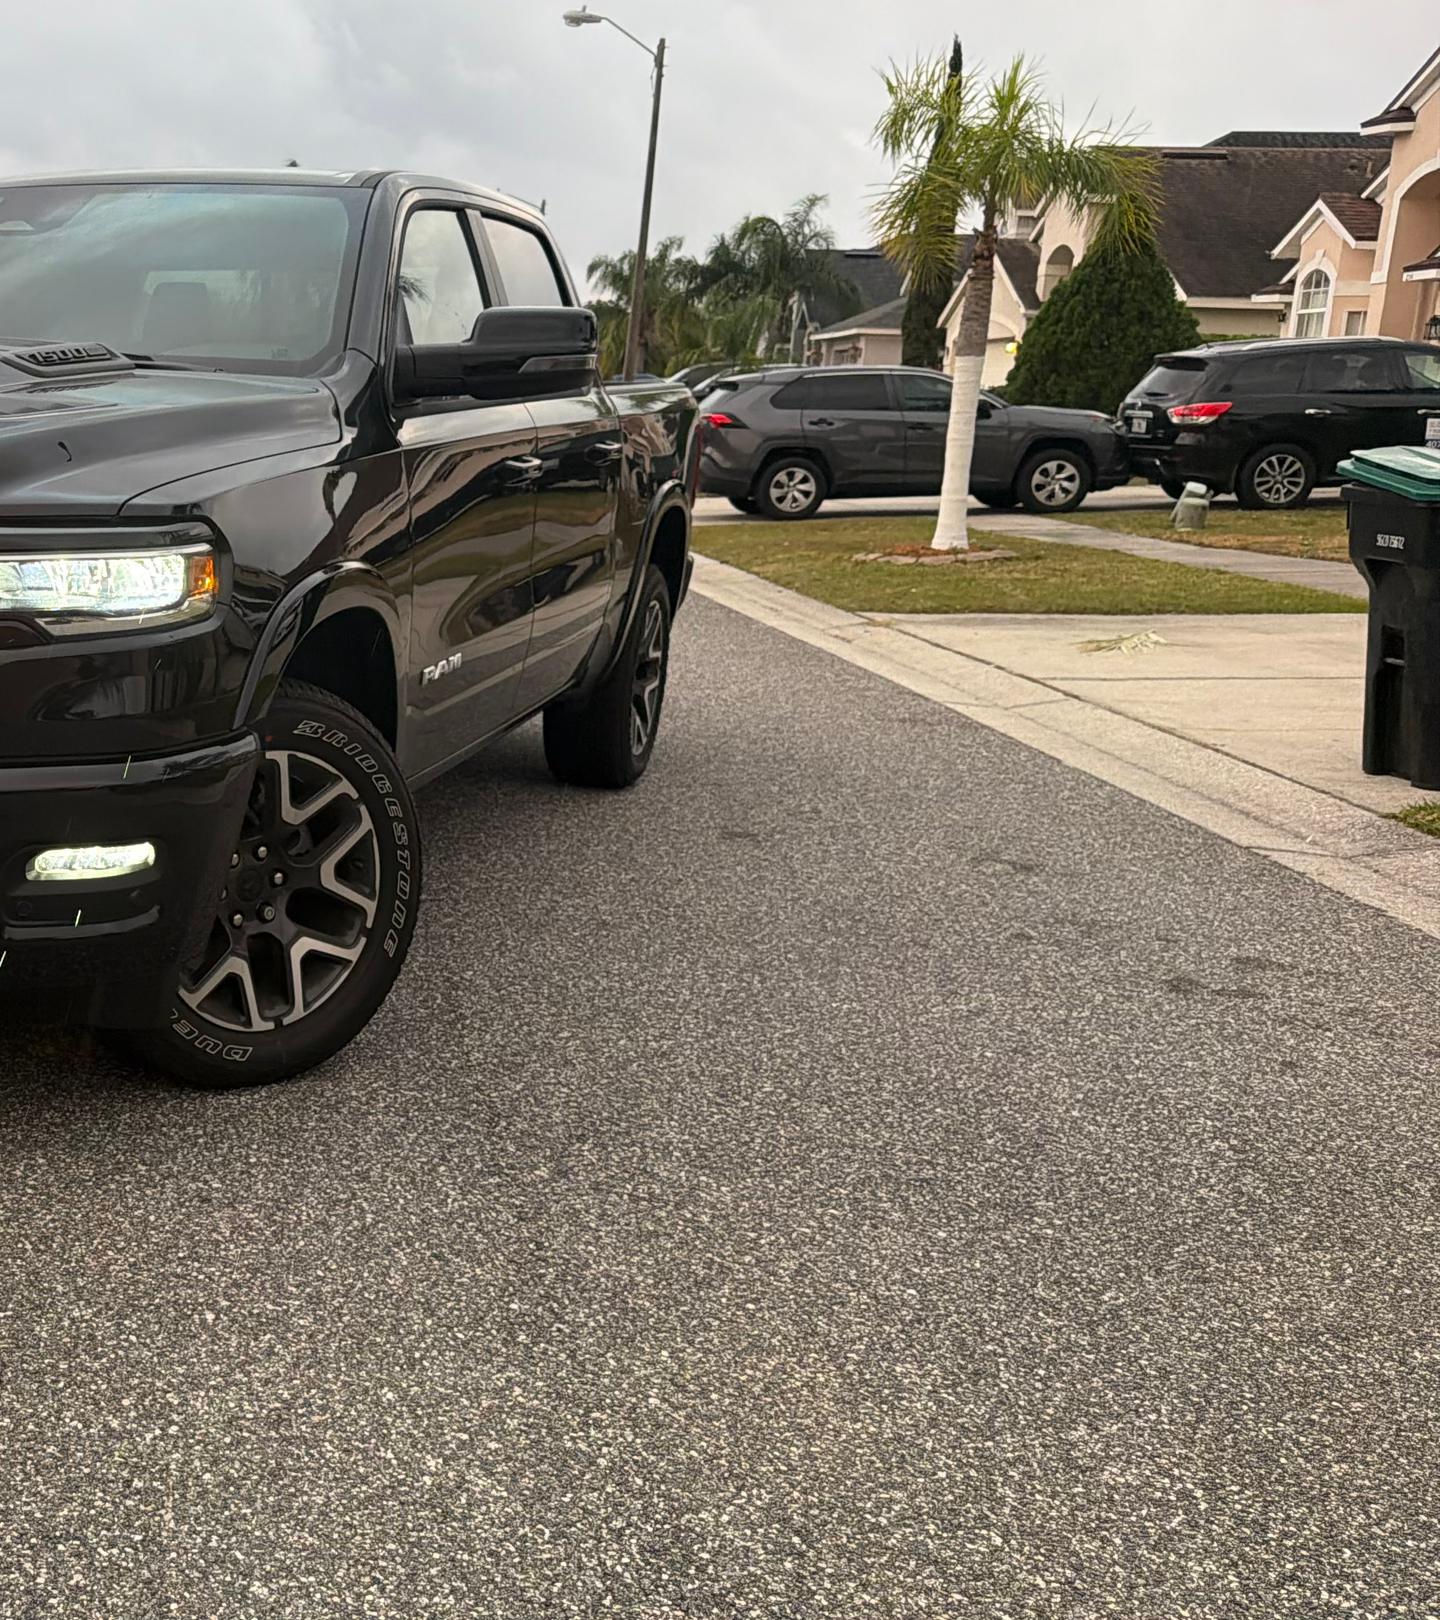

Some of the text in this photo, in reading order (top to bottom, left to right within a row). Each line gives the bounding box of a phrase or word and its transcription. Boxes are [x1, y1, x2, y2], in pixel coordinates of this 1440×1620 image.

[33, 347, 88, 364] 1500
[422, 652, 462, 686] RAM
[293, 720, 410, 958] BRIDGESTONE
